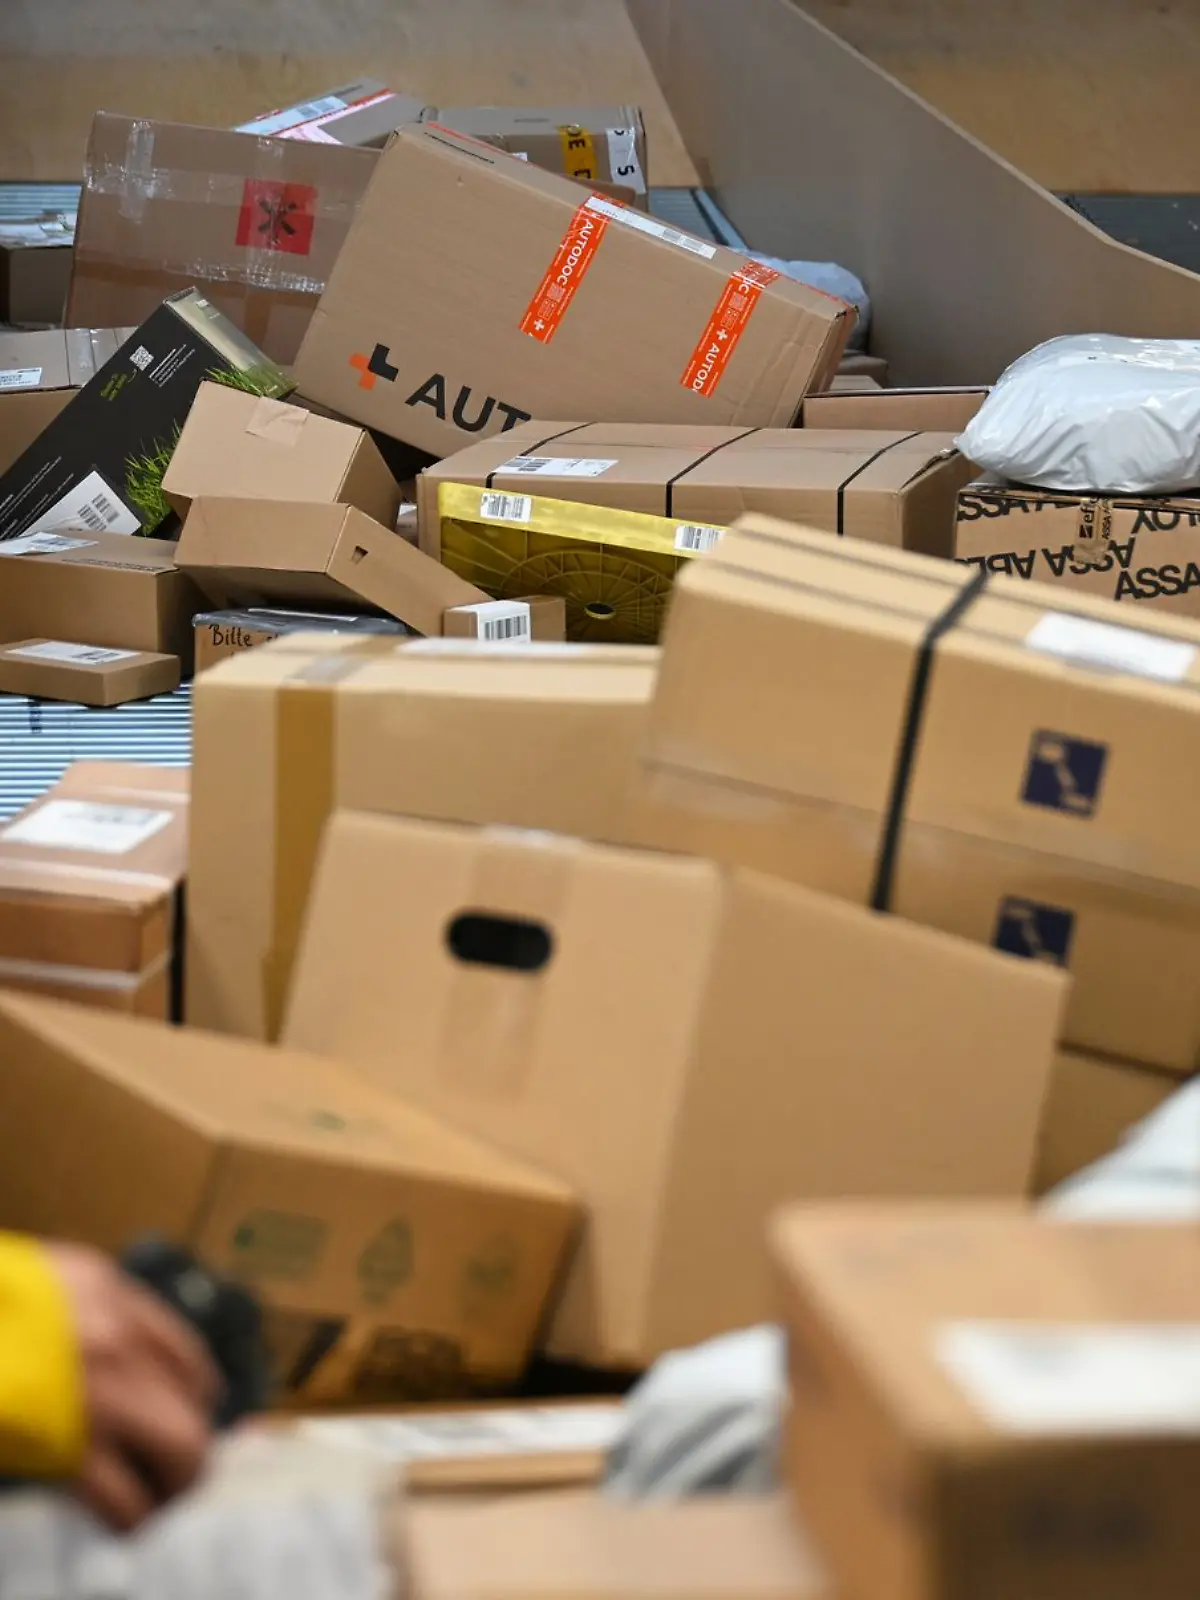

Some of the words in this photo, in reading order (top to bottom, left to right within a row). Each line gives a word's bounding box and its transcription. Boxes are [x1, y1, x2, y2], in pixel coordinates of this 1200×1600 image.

[556, 218, 594, 286] AUTODOC
[692, 343, 720, 393] AUTOD
[404, 373, 532, 433] AUT
[1114, 562, 1200, 602] ASSA
